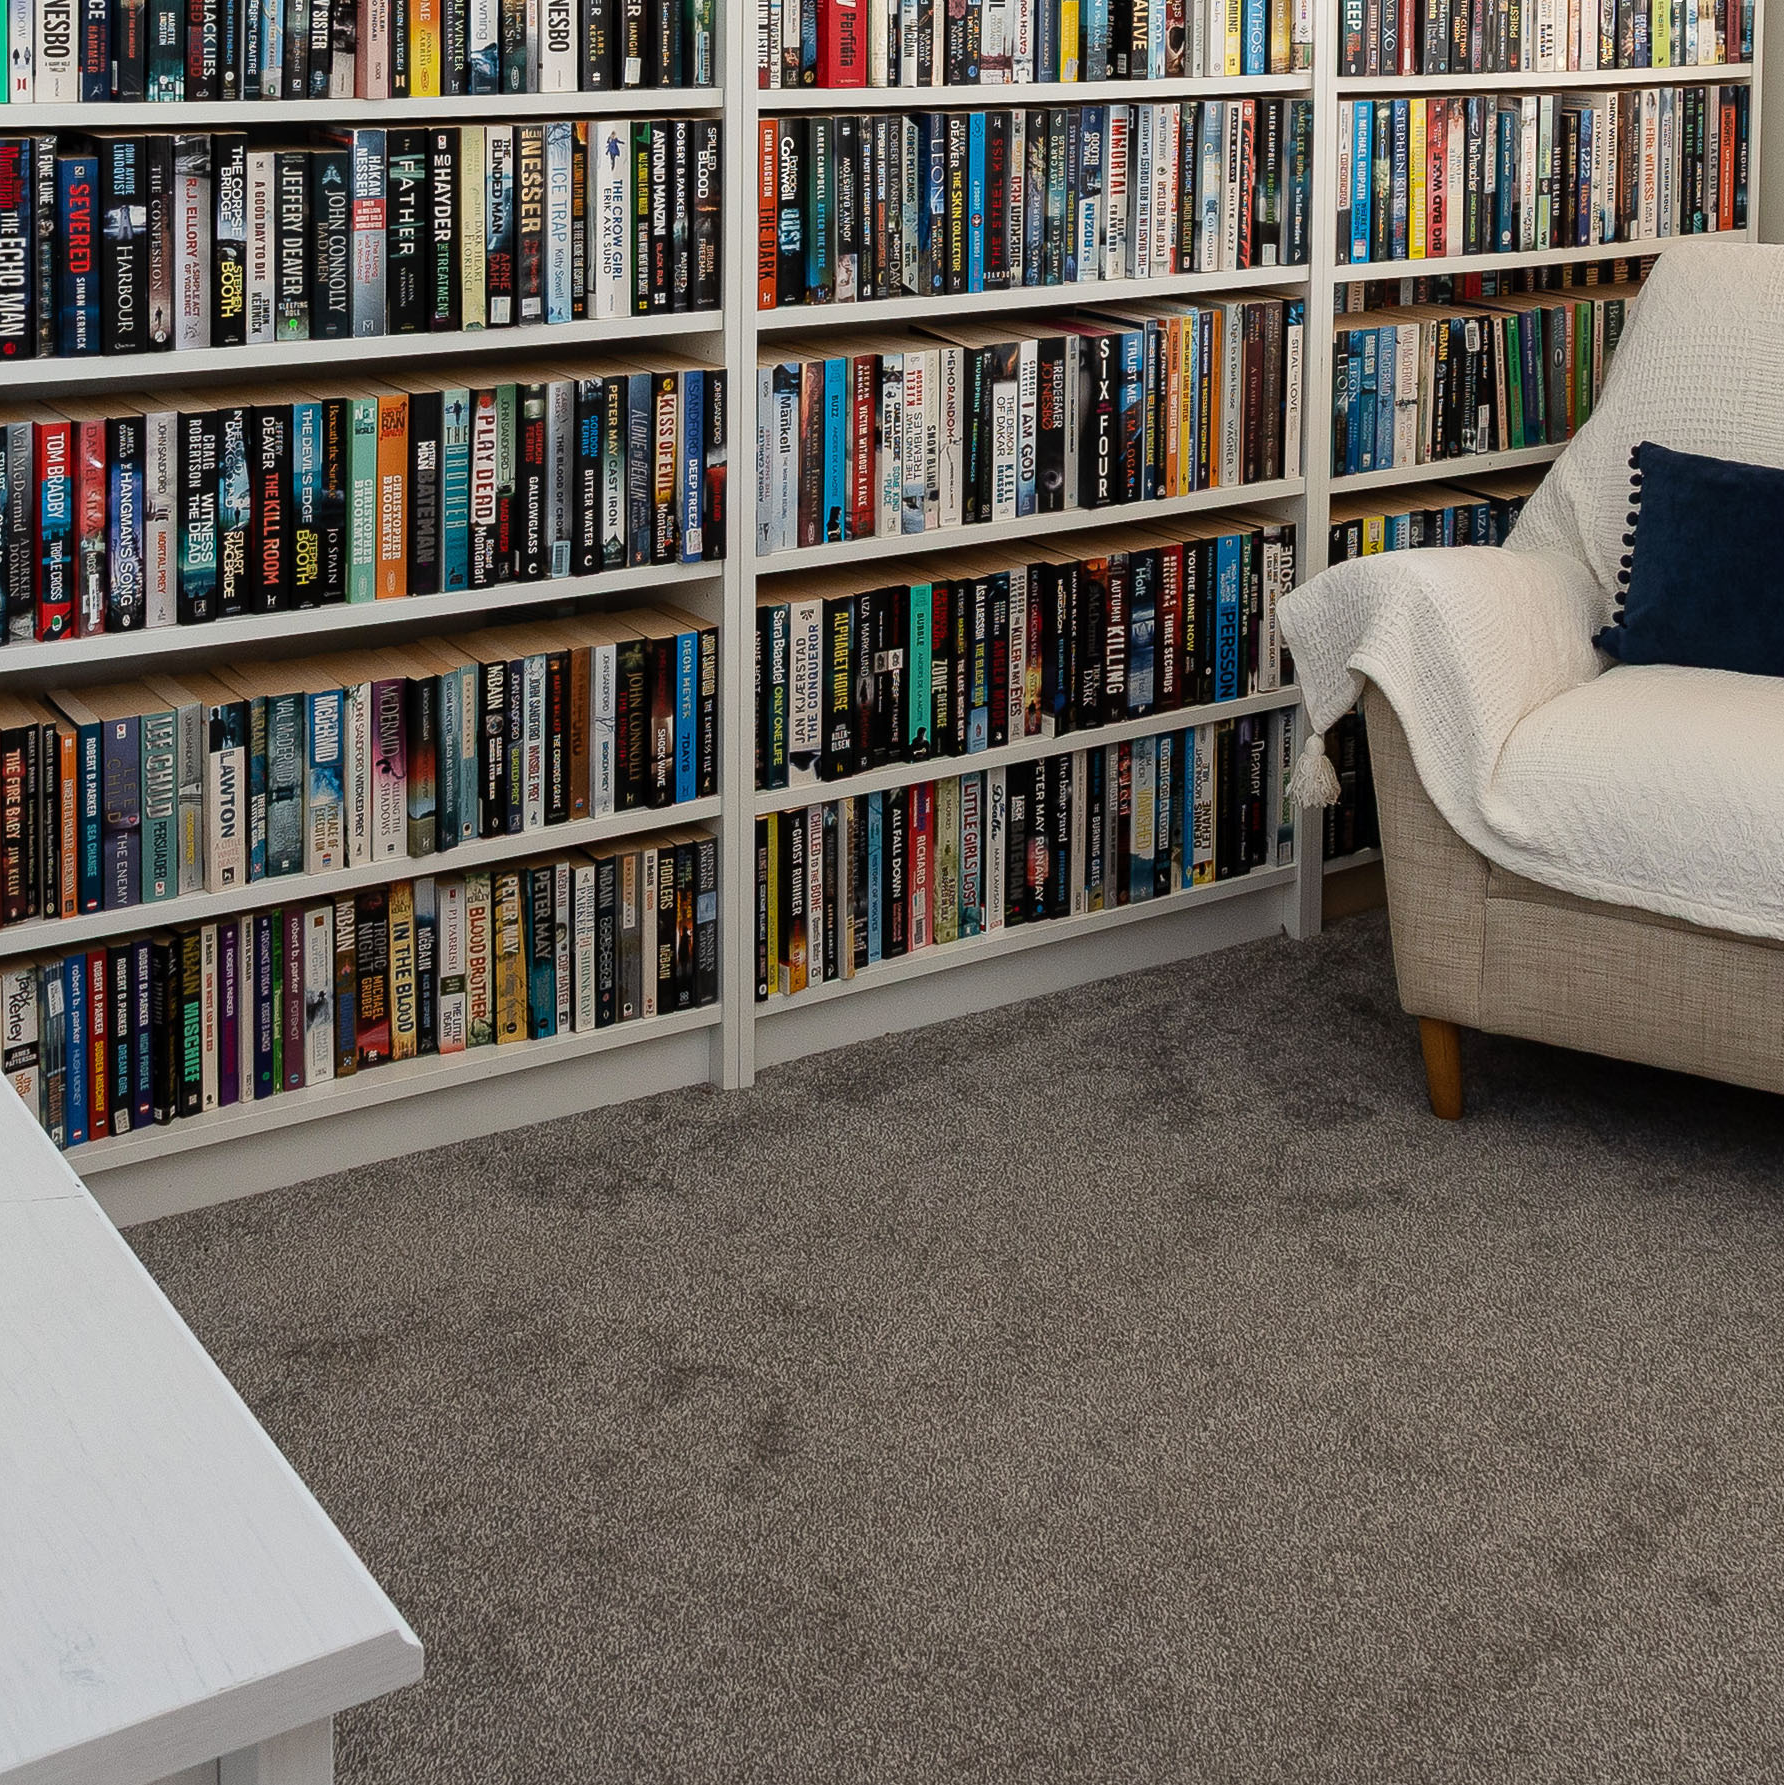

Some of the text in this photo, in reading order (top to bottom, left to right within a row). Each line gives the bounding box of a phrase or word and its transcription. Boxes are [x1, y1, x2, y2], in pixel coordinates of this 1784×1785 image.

[69, 185, 90, 273] SEVERED
[283, 167, 303, 295] JEFFERY DEAVER
[399, 161, 414, 255] FATHER
[434, 168, 451, 242] HAYDER
[552, 168, 566, 241] ICE TRAP
[613, 180, 623, 280] THE CROW GIRL
[951, 121, 961, 272] DEAVER THE SKIN COLLECTOR
[1432, 194, 1442, 225] BAD
[326, 190, 346, 312] JOHN CONNOLLY
[759, 205, 774, 280] THE DARK
[1432, 227, 1442, 251] BIG
[118, 246, 133, 332] HARBOUR
[1053, 366, 1063, 428] REDEEMER
[1100, 339, 1109, 401] SIX
[1127, 339, 1137, 403] TRUST ME
[47, 434, 64, 520] TOM BRADBY
[475, 416, 494, 522] PLAY DEAD
[914, 412, 922, 480] TREMBLES
[1022, 415, 1034, 481] AM GOD
[1100, 416, 1108, 497] FOUR
[264, 474, 279, 584] THE KILL ROOM
[297, 530, 309, 584] BOOTH
[121, 563, 133, 607] SONG
[807, 624, 819, 741] THE CONQUEROR
[834, 613, 847, 712] ALPHABET HOUSE
[1106, 626, 1124, 694] KILLING
[1220, 610, 1235, 698] PERSSON
[774, 687, 782, 765] ONLY ONE LIFE
[220, 755, 236, 838] LAWTON
[1194, 805, 1202, 849] DENNIS
[1201, 800, 1211, 849] LEHANE
[118, 833, 127, 904] THE ENEMY
[963, 784, 978, 908] LITTLE GIRLS LOST
[1035, 805, 1044, 901] MAY RUNAWAY
[393, 922, 413, 1032] IN THE BLOOD
[469, 907, 487, 1019] BLOOD BROTHER
[184, 1003, 199, 1082] MISCHIEF
